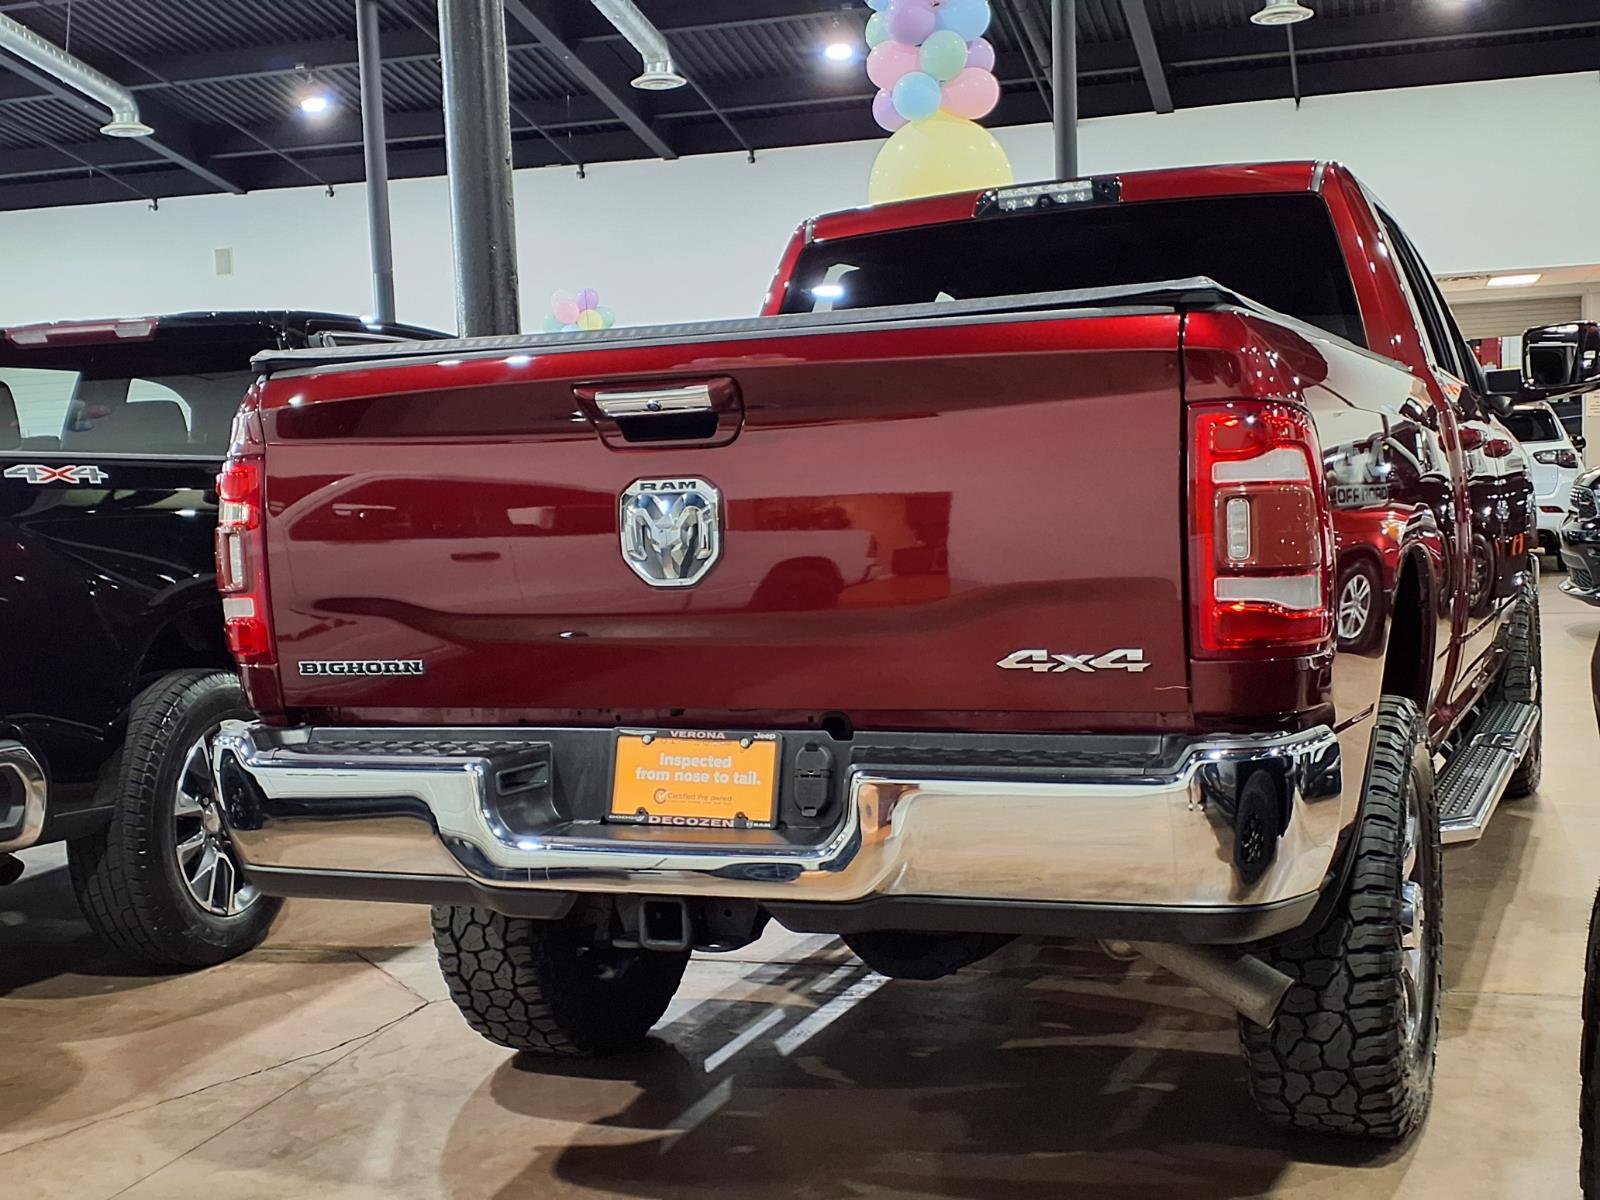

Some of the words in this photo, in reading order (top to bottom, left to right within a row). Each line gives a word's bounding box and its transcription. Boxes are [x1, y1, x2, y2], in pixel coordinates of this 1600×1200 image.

[639, 481, 697, 491] RAM
[1337, 488, 1359, 504] OFF
[298, 659, 423, 675] BIGHORN
[670, 730, 726, 739] VERONA
[753, 732, 776, 740] Jeep
[659, 752, 732, 769] Inspected
[635, 766, 670, 781] from
[674, 771, 710, 783] nose
[713, 770, 729, 784] to
[732, 771, 762, 785] tail.
[648, 815, 735, 828] DECOZEN
